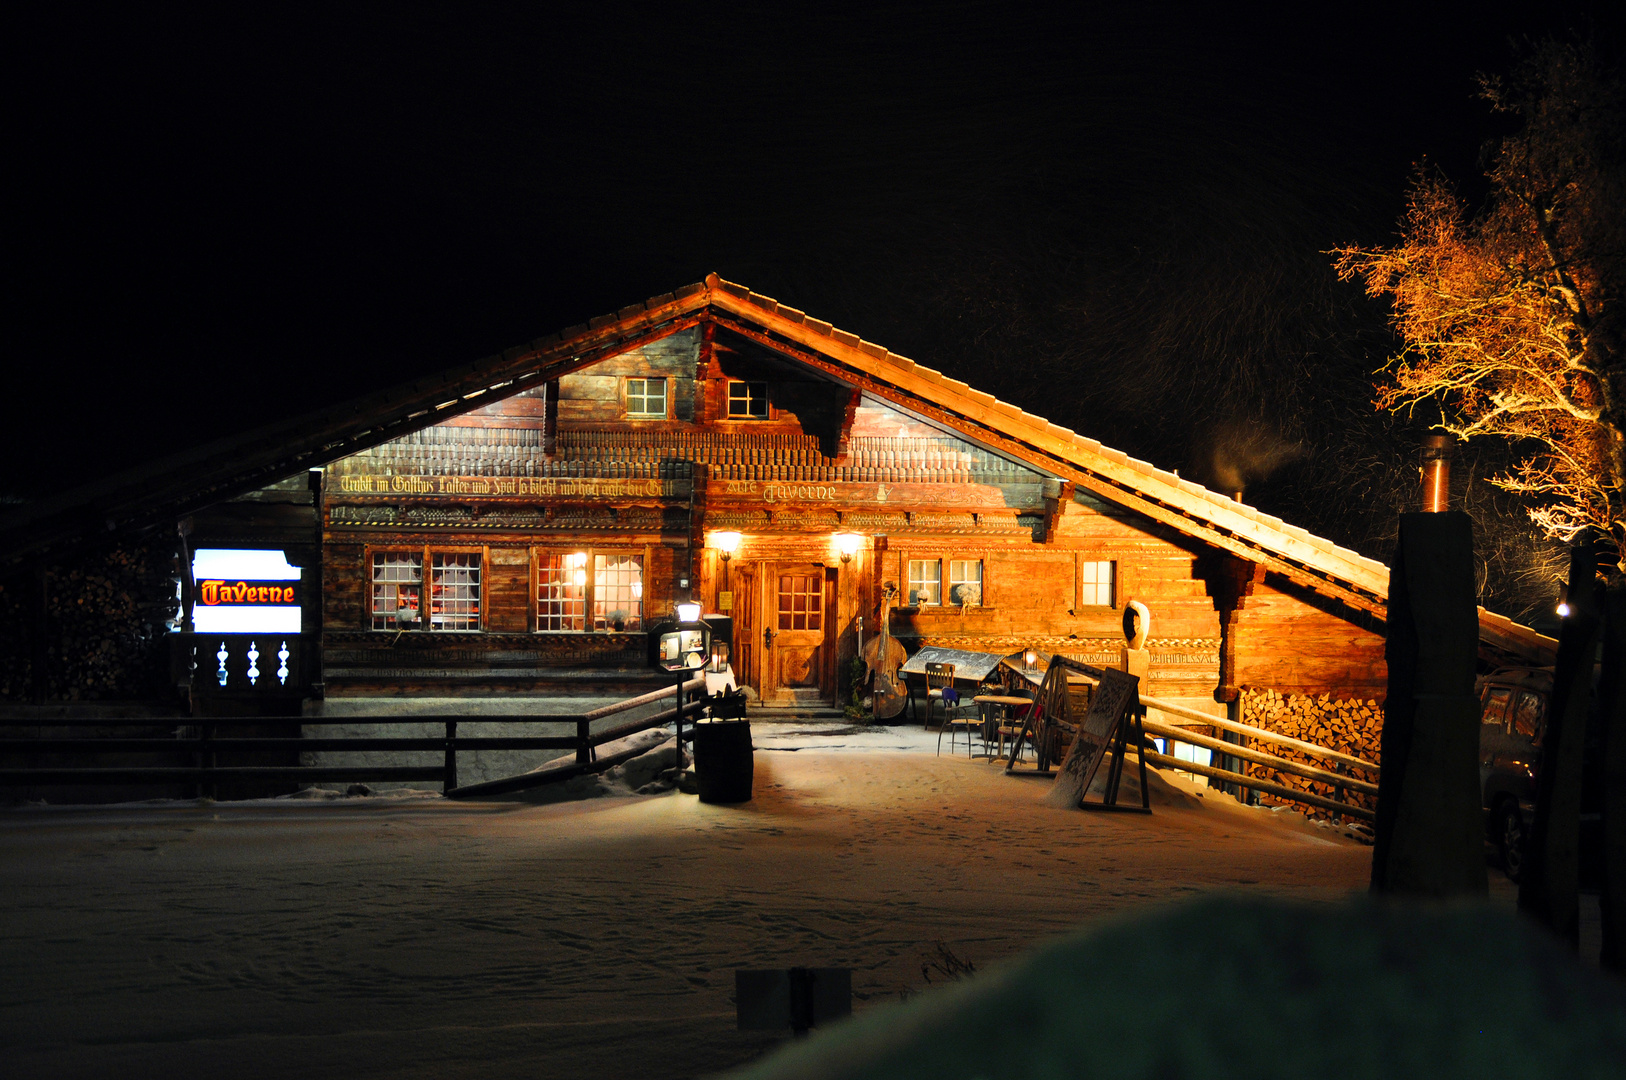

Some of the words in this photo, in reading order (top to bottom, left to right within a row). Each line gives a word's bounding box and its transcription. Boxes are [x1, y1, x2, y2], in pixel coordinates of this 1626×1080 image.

[376, 477, 389, 492] im
[391, 475, 434, 494] Gasthus
[438, 475, 470, 494] Laster
[472, 479, 489, 494] und
[726, 482, 758, 494] ALTE
[763, 484, 836, 503] Taverne
[201, 579, 295, 606] Taverne
